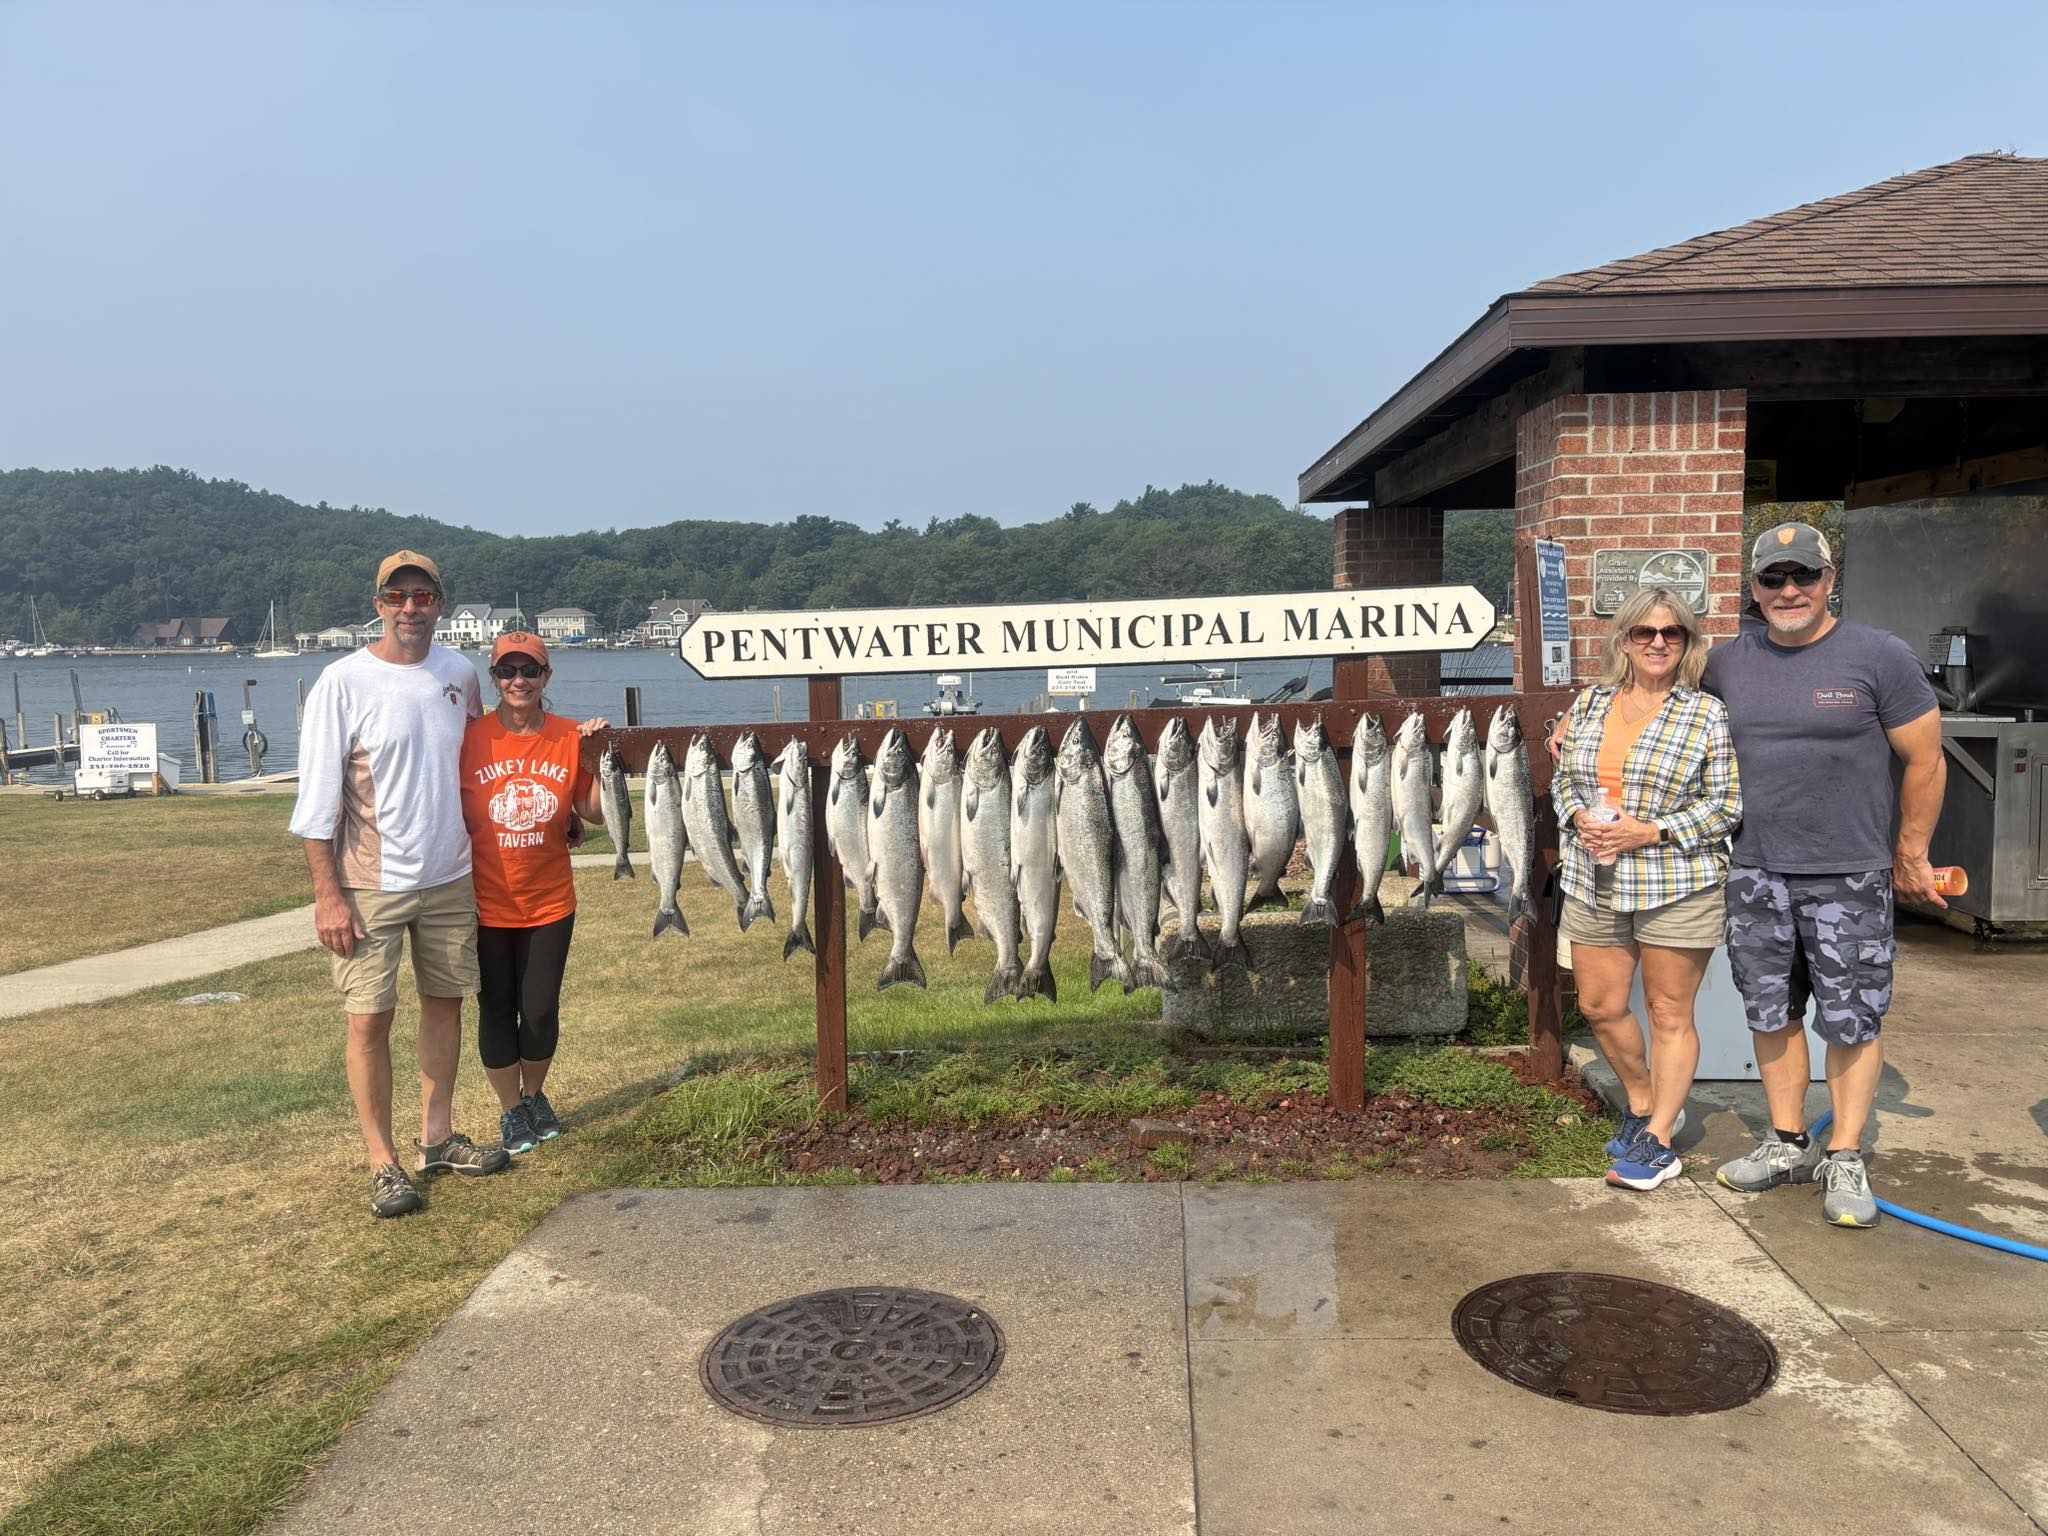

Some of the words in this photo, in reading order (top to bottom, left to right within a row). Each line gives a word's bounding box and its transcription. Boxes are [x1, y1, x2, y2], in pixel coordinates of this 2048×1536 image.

[1608, 559, 1628, 567] Grant
[1628, 575, 1638, 583] By
[702, 621, 985, 663] PENTWATER
[1002, 611, 1264, 653] MUNICIPAL
[1284, 602, 1474, 642] MARINA
[98, 727, 138, 735] SPORTSMEN
[474, 758, 525, 784] ZUKEY
[530, 759, 569, 783] LAKE
[497, 831, 545, 848] TAVERN
